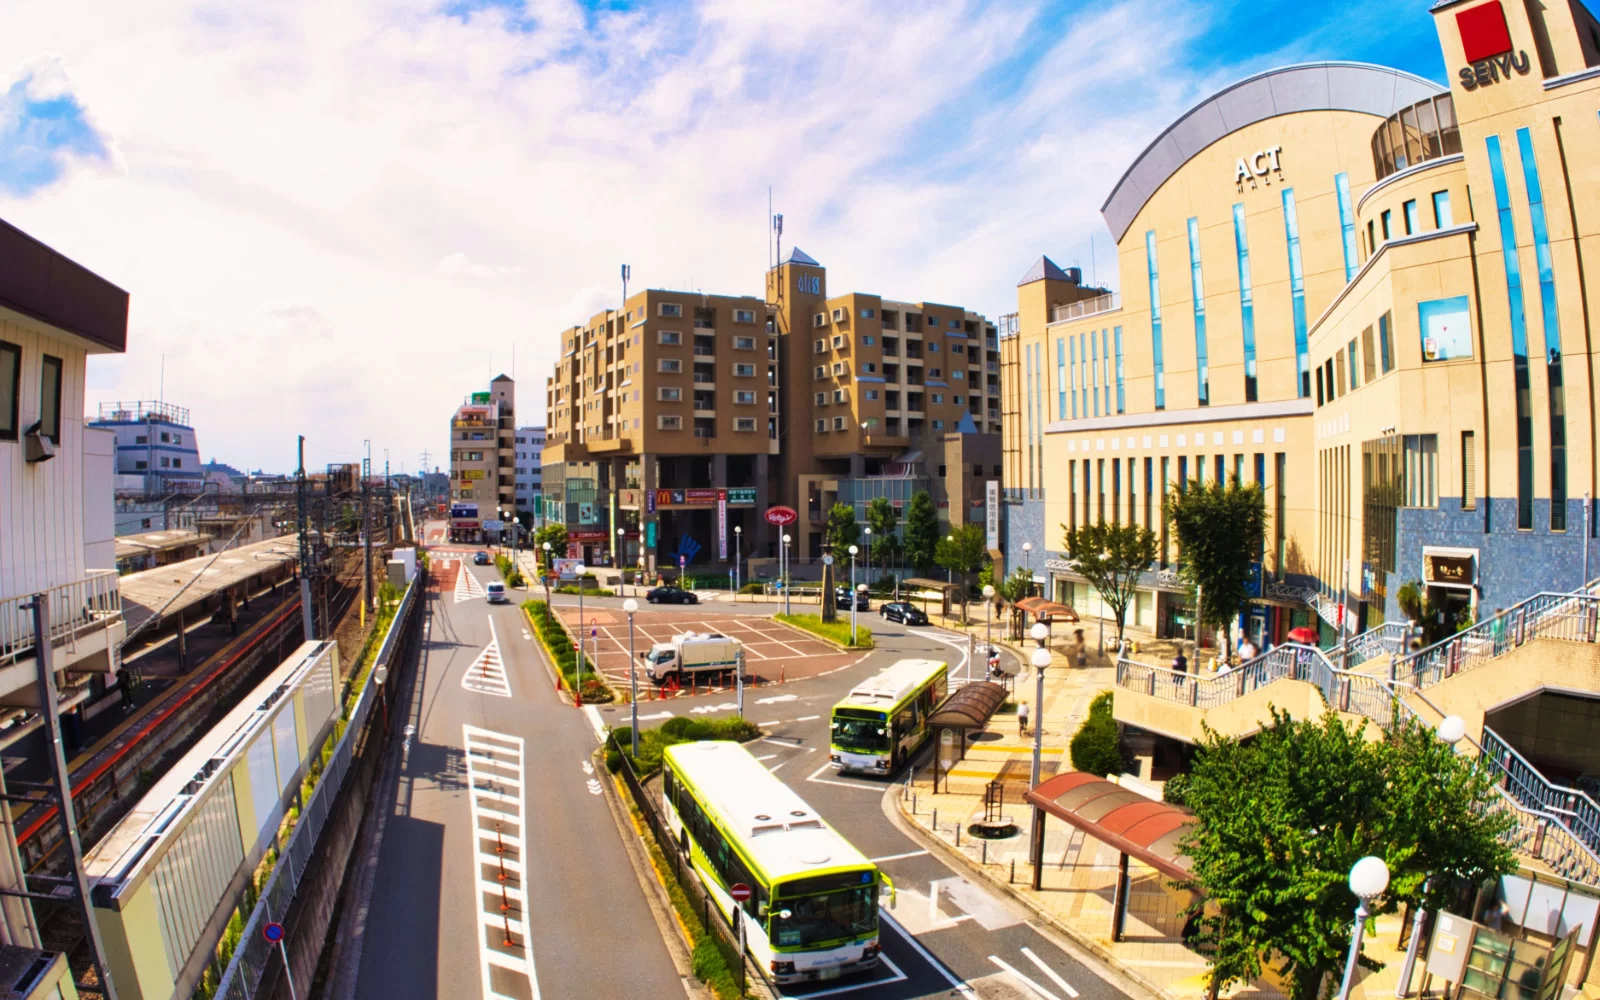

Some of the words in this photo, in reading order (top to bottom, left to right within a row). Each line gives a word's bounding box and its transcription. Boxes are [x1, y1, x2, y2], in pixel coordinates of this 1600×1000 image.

[1459, 49, 1530, 92] SEIYU
[1234, 144, 1282, 185] ACT
[1237, 172, 1285, 194] HALL
